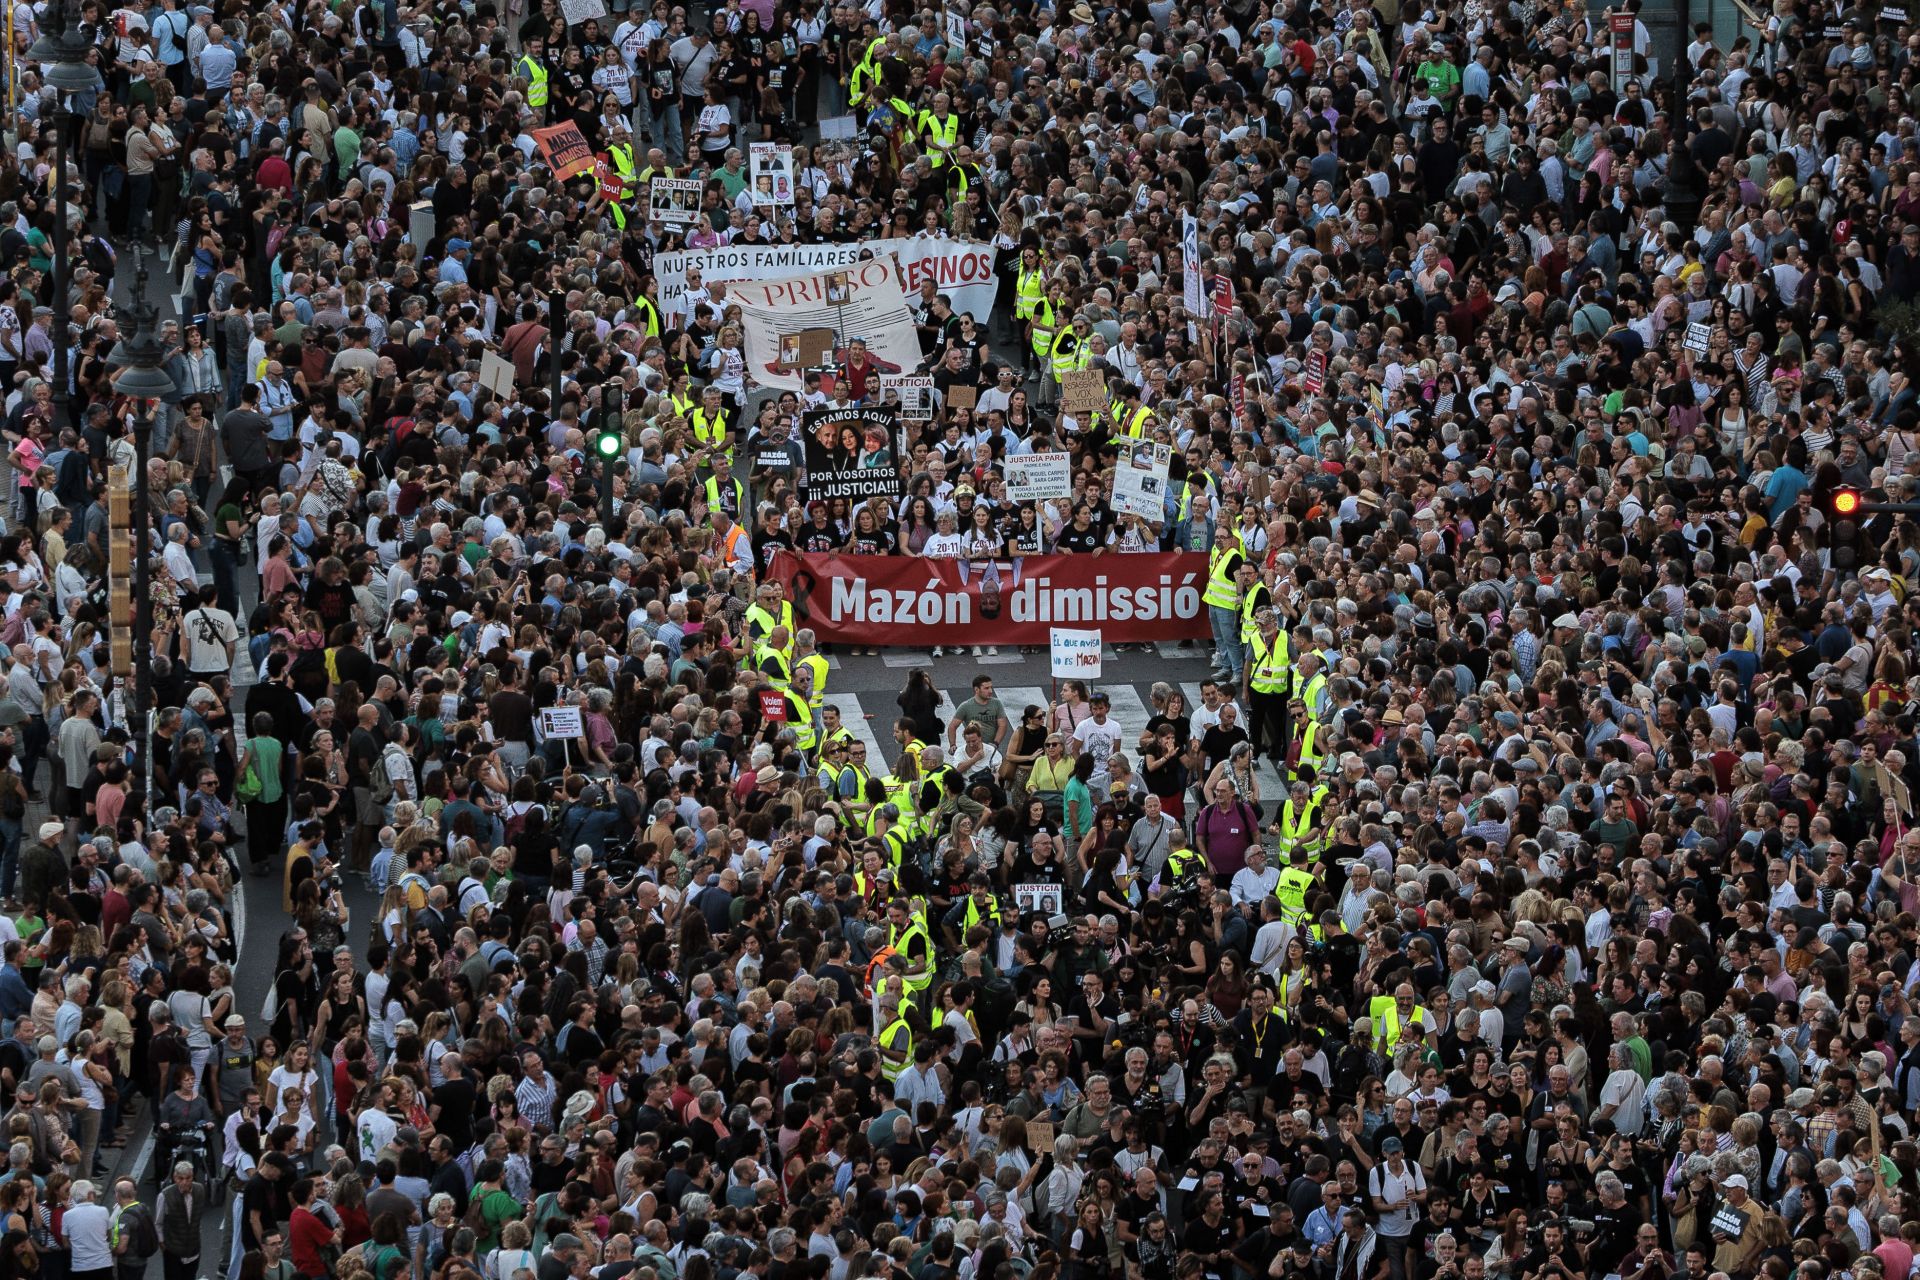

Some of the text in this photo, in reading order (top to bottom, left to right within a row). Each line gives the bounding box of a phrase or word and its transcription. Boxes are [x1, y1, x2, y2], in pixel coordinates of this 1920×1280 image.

[653, 178, 702, 190] JUSTICIA
[663, 250, 857, 274] NUESTROS FAMILIARES
[882, 379, 933, 387] JUSTICIA
[808, 410, 893, 434] ESTAMOS AQUÍ
[760, 450, 788, 459] MAZÓN
[757, 456, 791, 466] DIMISSIÓ
[810, 467, 896, 482] POR VOSOTROS
[824, 480, 900, 497] JUSTICIA!!!
[936, 542, 959, 552] 20:11
[831, 573, 1200, 624] Mazón dimissió
[1064, 639, 1078, 647] QUE
[1064, 657, 1073, 666] ES
[763, 696, 783, 705] Volem
[766, 706, 783, 715] votar.
[1017, 884, 1060, 892] JUSTICIA
